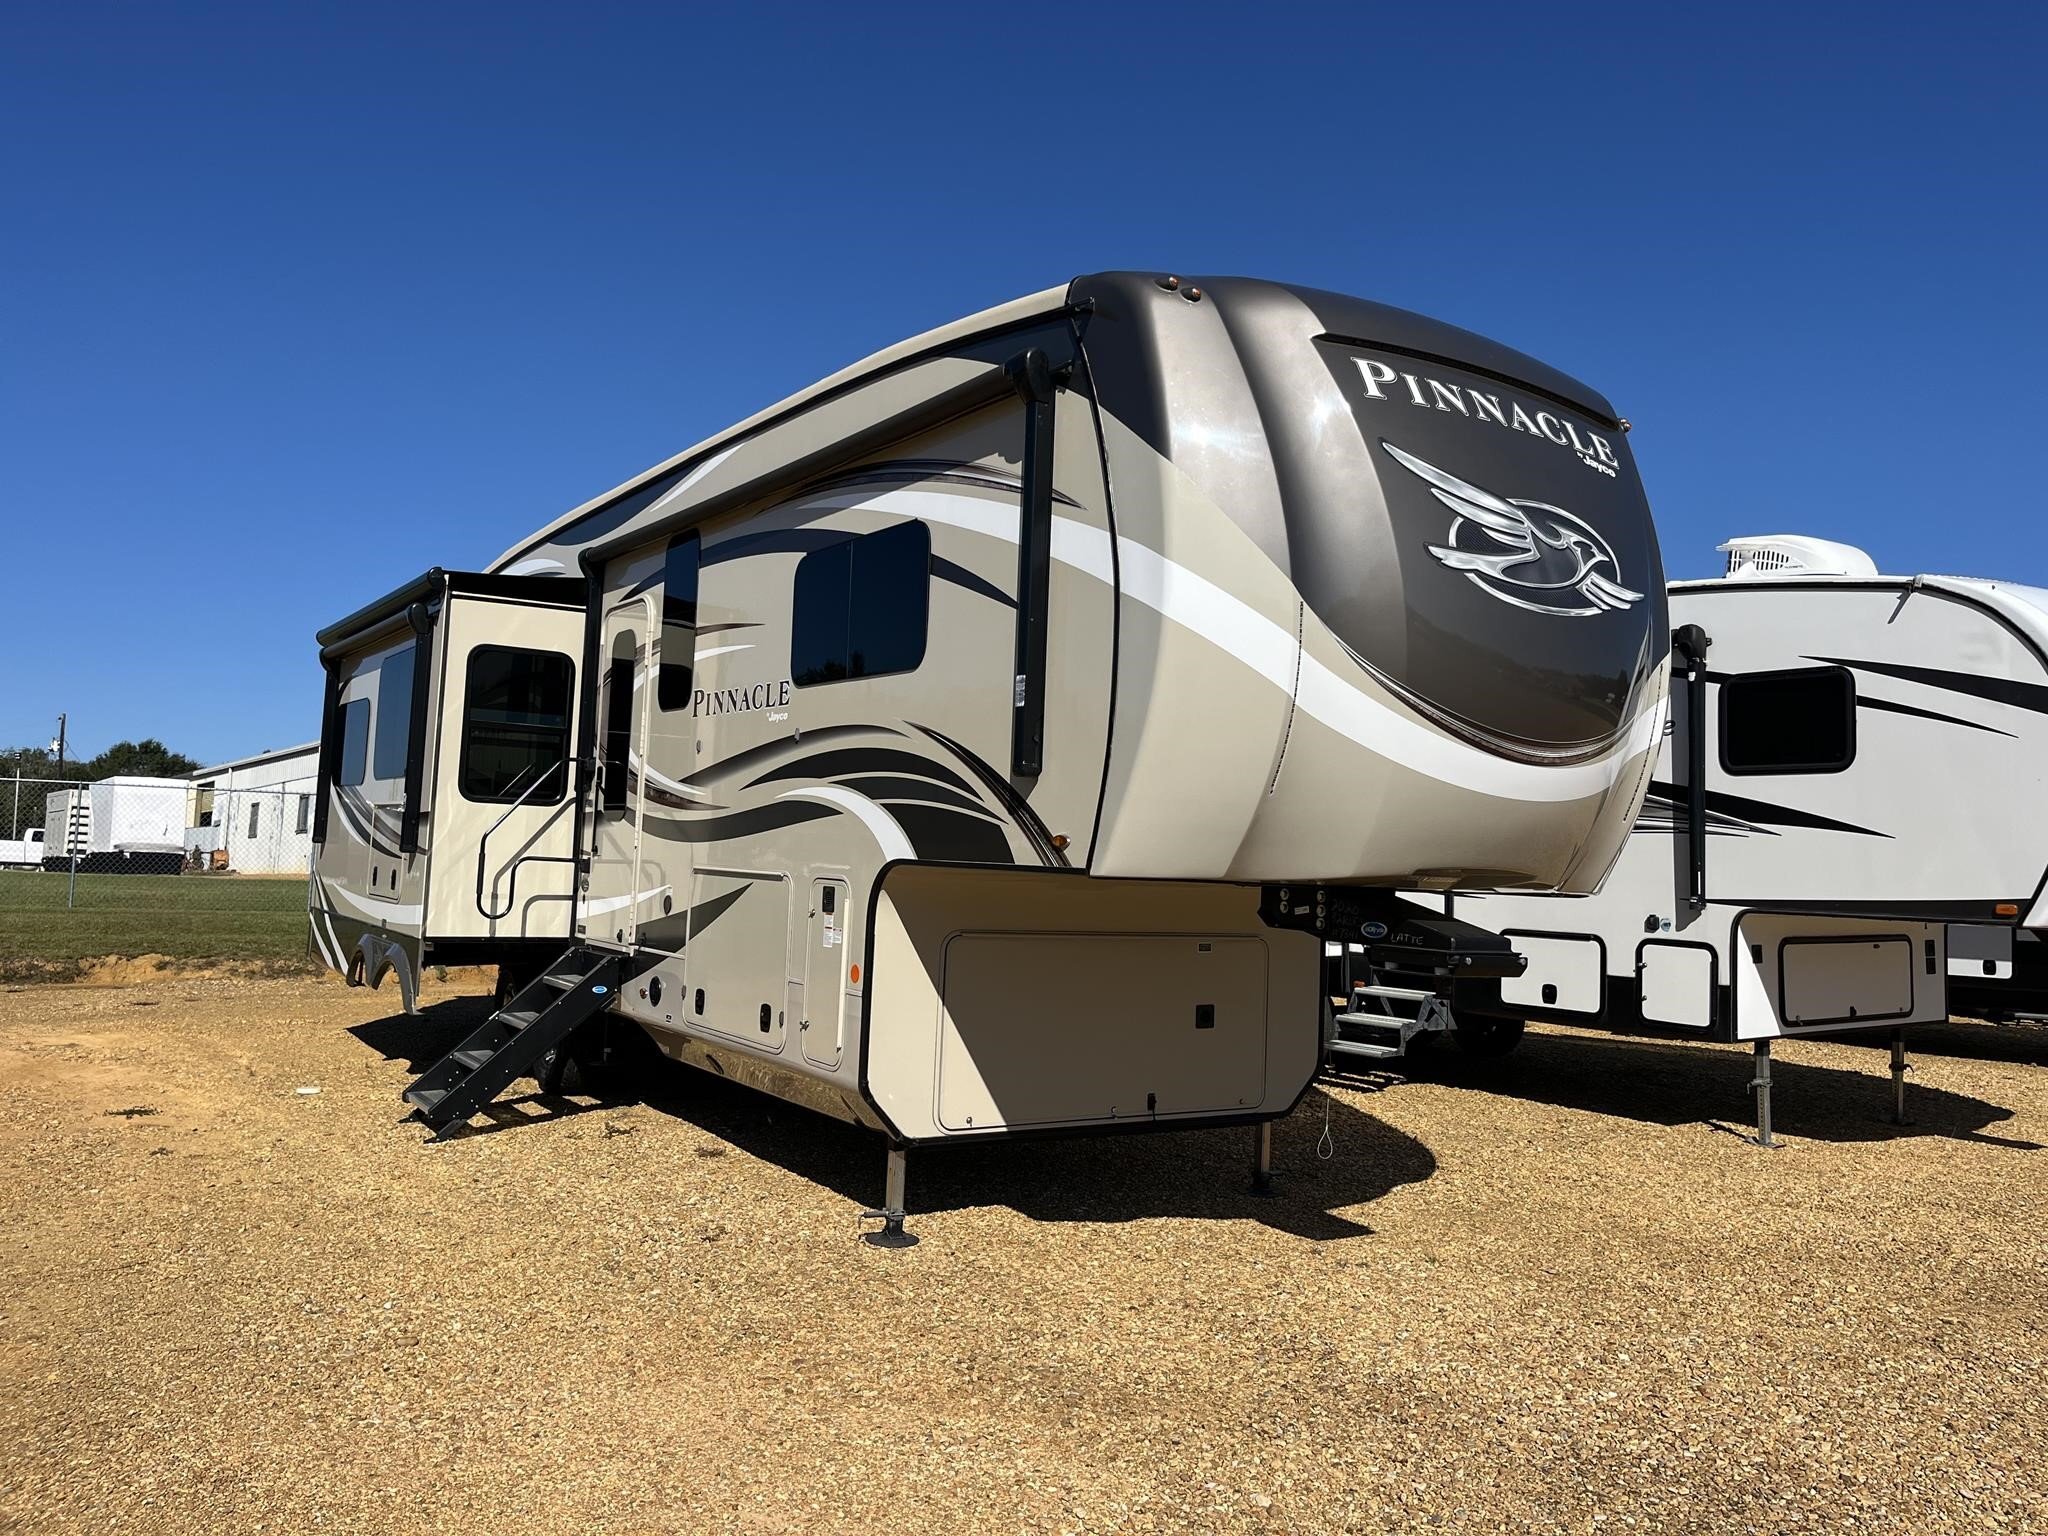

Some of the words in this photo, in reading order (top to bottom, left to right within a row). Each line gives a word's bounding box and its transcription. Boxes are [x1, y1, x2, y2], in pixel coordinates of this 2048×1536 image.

[1350, 356, 1620, 470] PINNACLE
[1582, 454, 1616, 478] Jayco
[692, 680, 791, 718] PINNACLE
[1390, 932, 1424, 945] LATTE
